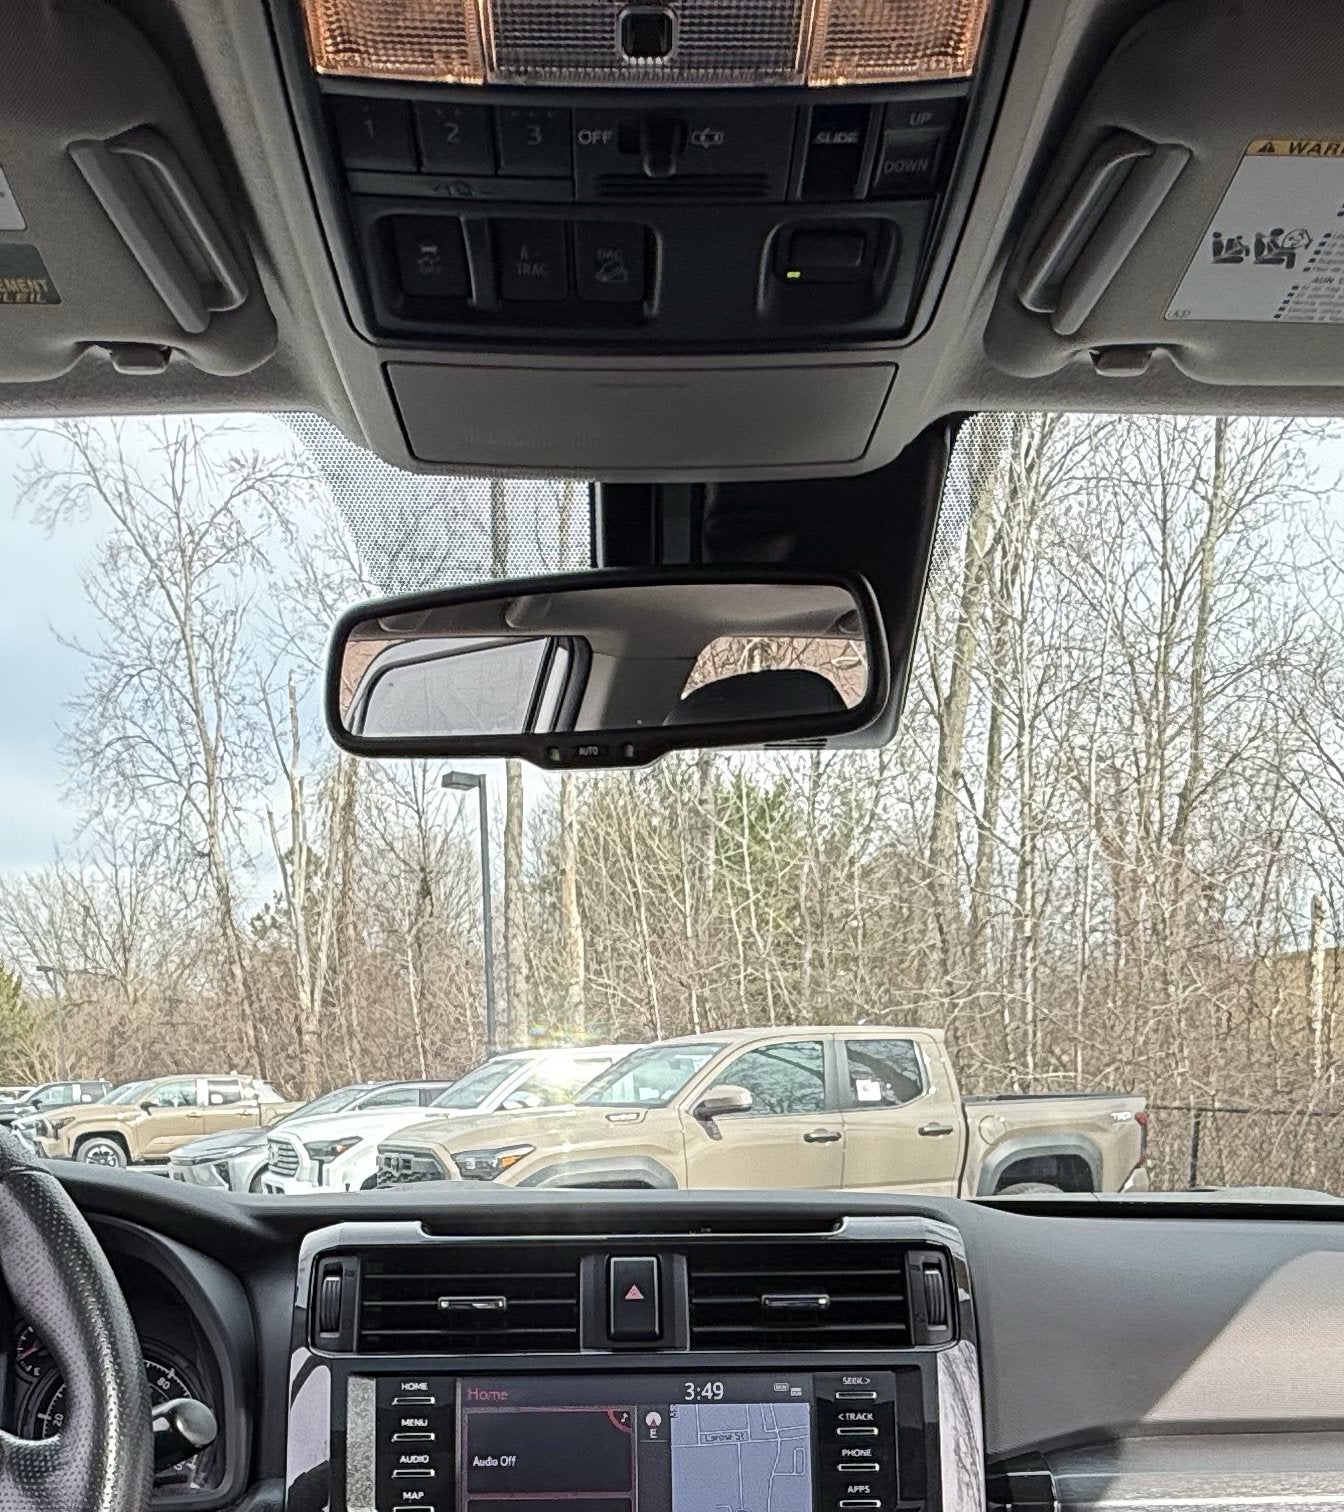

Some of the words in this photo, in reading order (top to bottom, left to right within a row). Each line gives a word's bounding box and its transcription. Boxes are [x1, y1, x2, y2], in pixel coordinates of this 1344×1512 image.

[909, 112, 932, 125] UP
[444, 122, 460, 143] 2
[527, 126, 543, 145] 3
[577, 131, 613, 145] OFF
[814, 132, 859, 144] SLIDE
[884, 159, 929, 173] DOWN
[156, 1376, 171, 1390] 80
[401, 1382, 428, 1391] HOME
[466, 1387, 509, 1402] Home
[684, 1382, 724, 1401] 3:49
[53, 1413, 64, 1427] 20
[401, 1418, 428, 1428] MENU
[842, 1448, 873, 1457] PHONE
[399, 1455, 430, 1464] AUDIO
[472, 1455, 499, 1467] Audio
[500, 1455, 517, 1468] Off
[402, 1491, 424, 1500] MAP
[847, 1485, 871, 1494] APPS
